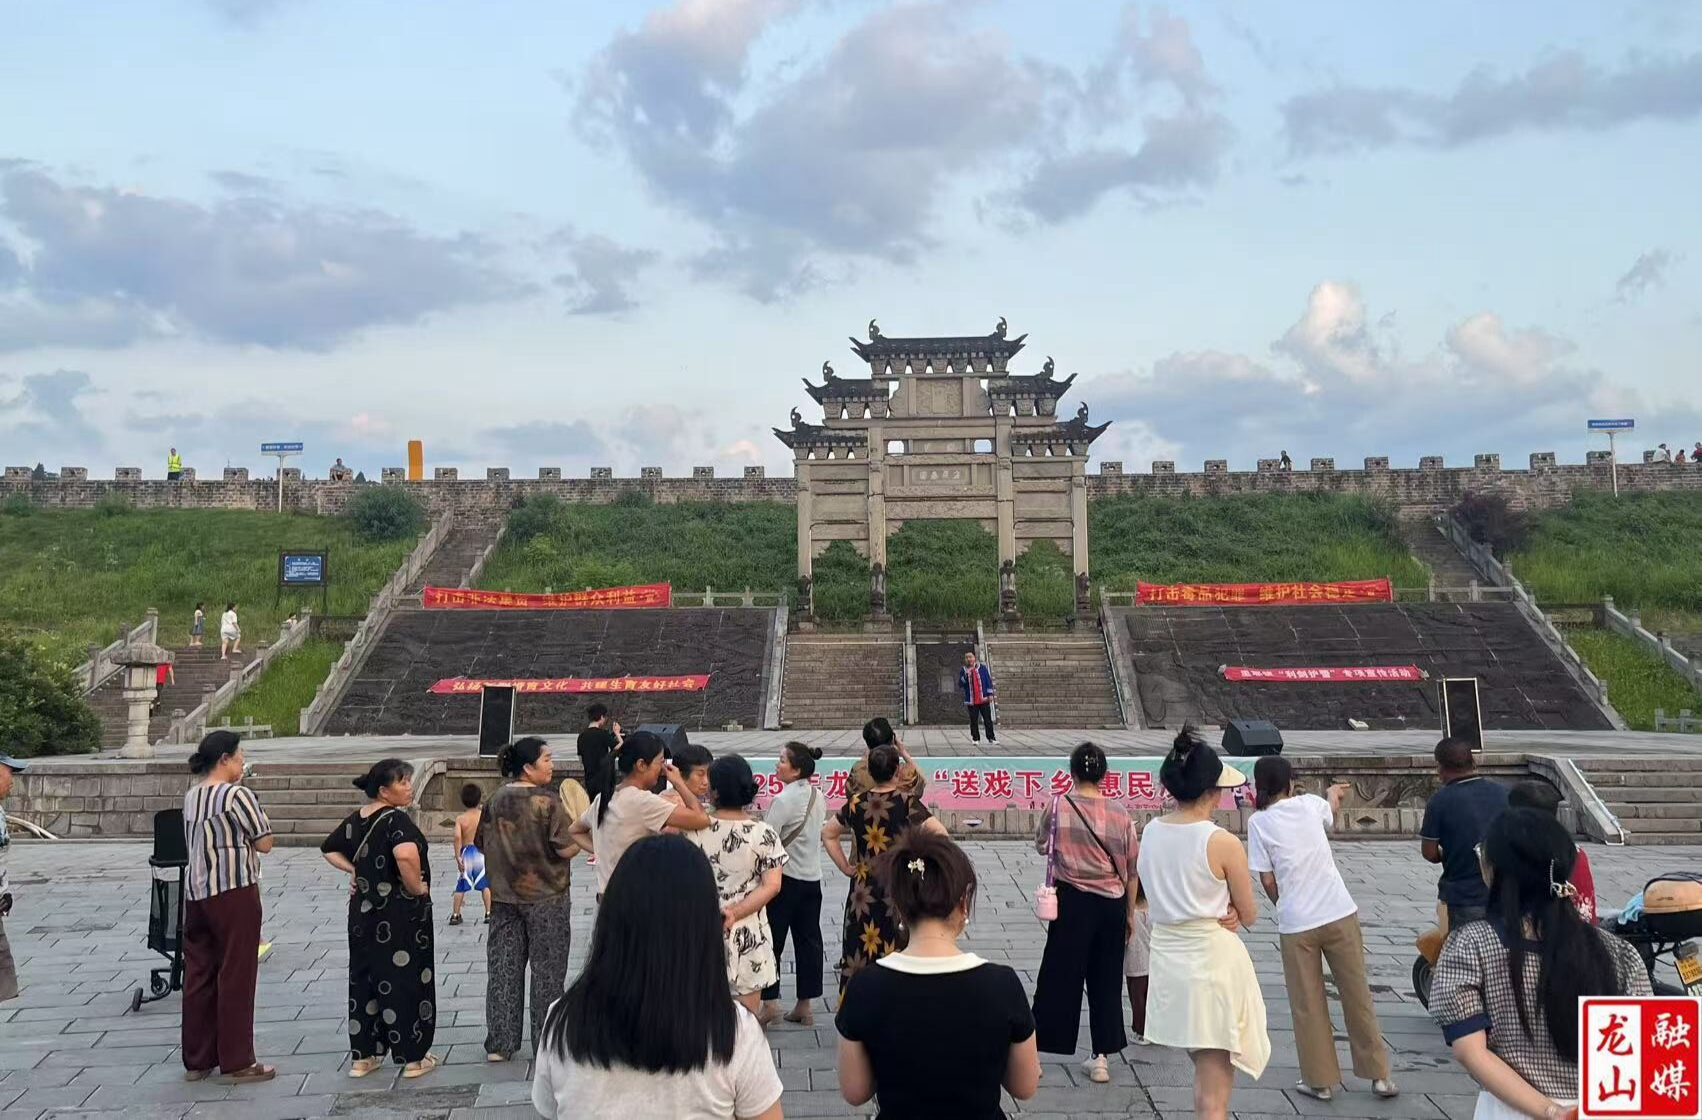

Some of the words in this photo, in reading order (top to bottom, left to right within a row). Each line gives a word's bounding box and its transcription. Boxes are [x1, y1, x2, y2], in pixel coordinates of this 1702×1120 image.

[453, 680, 569, 692] 弘扬婚育文化
